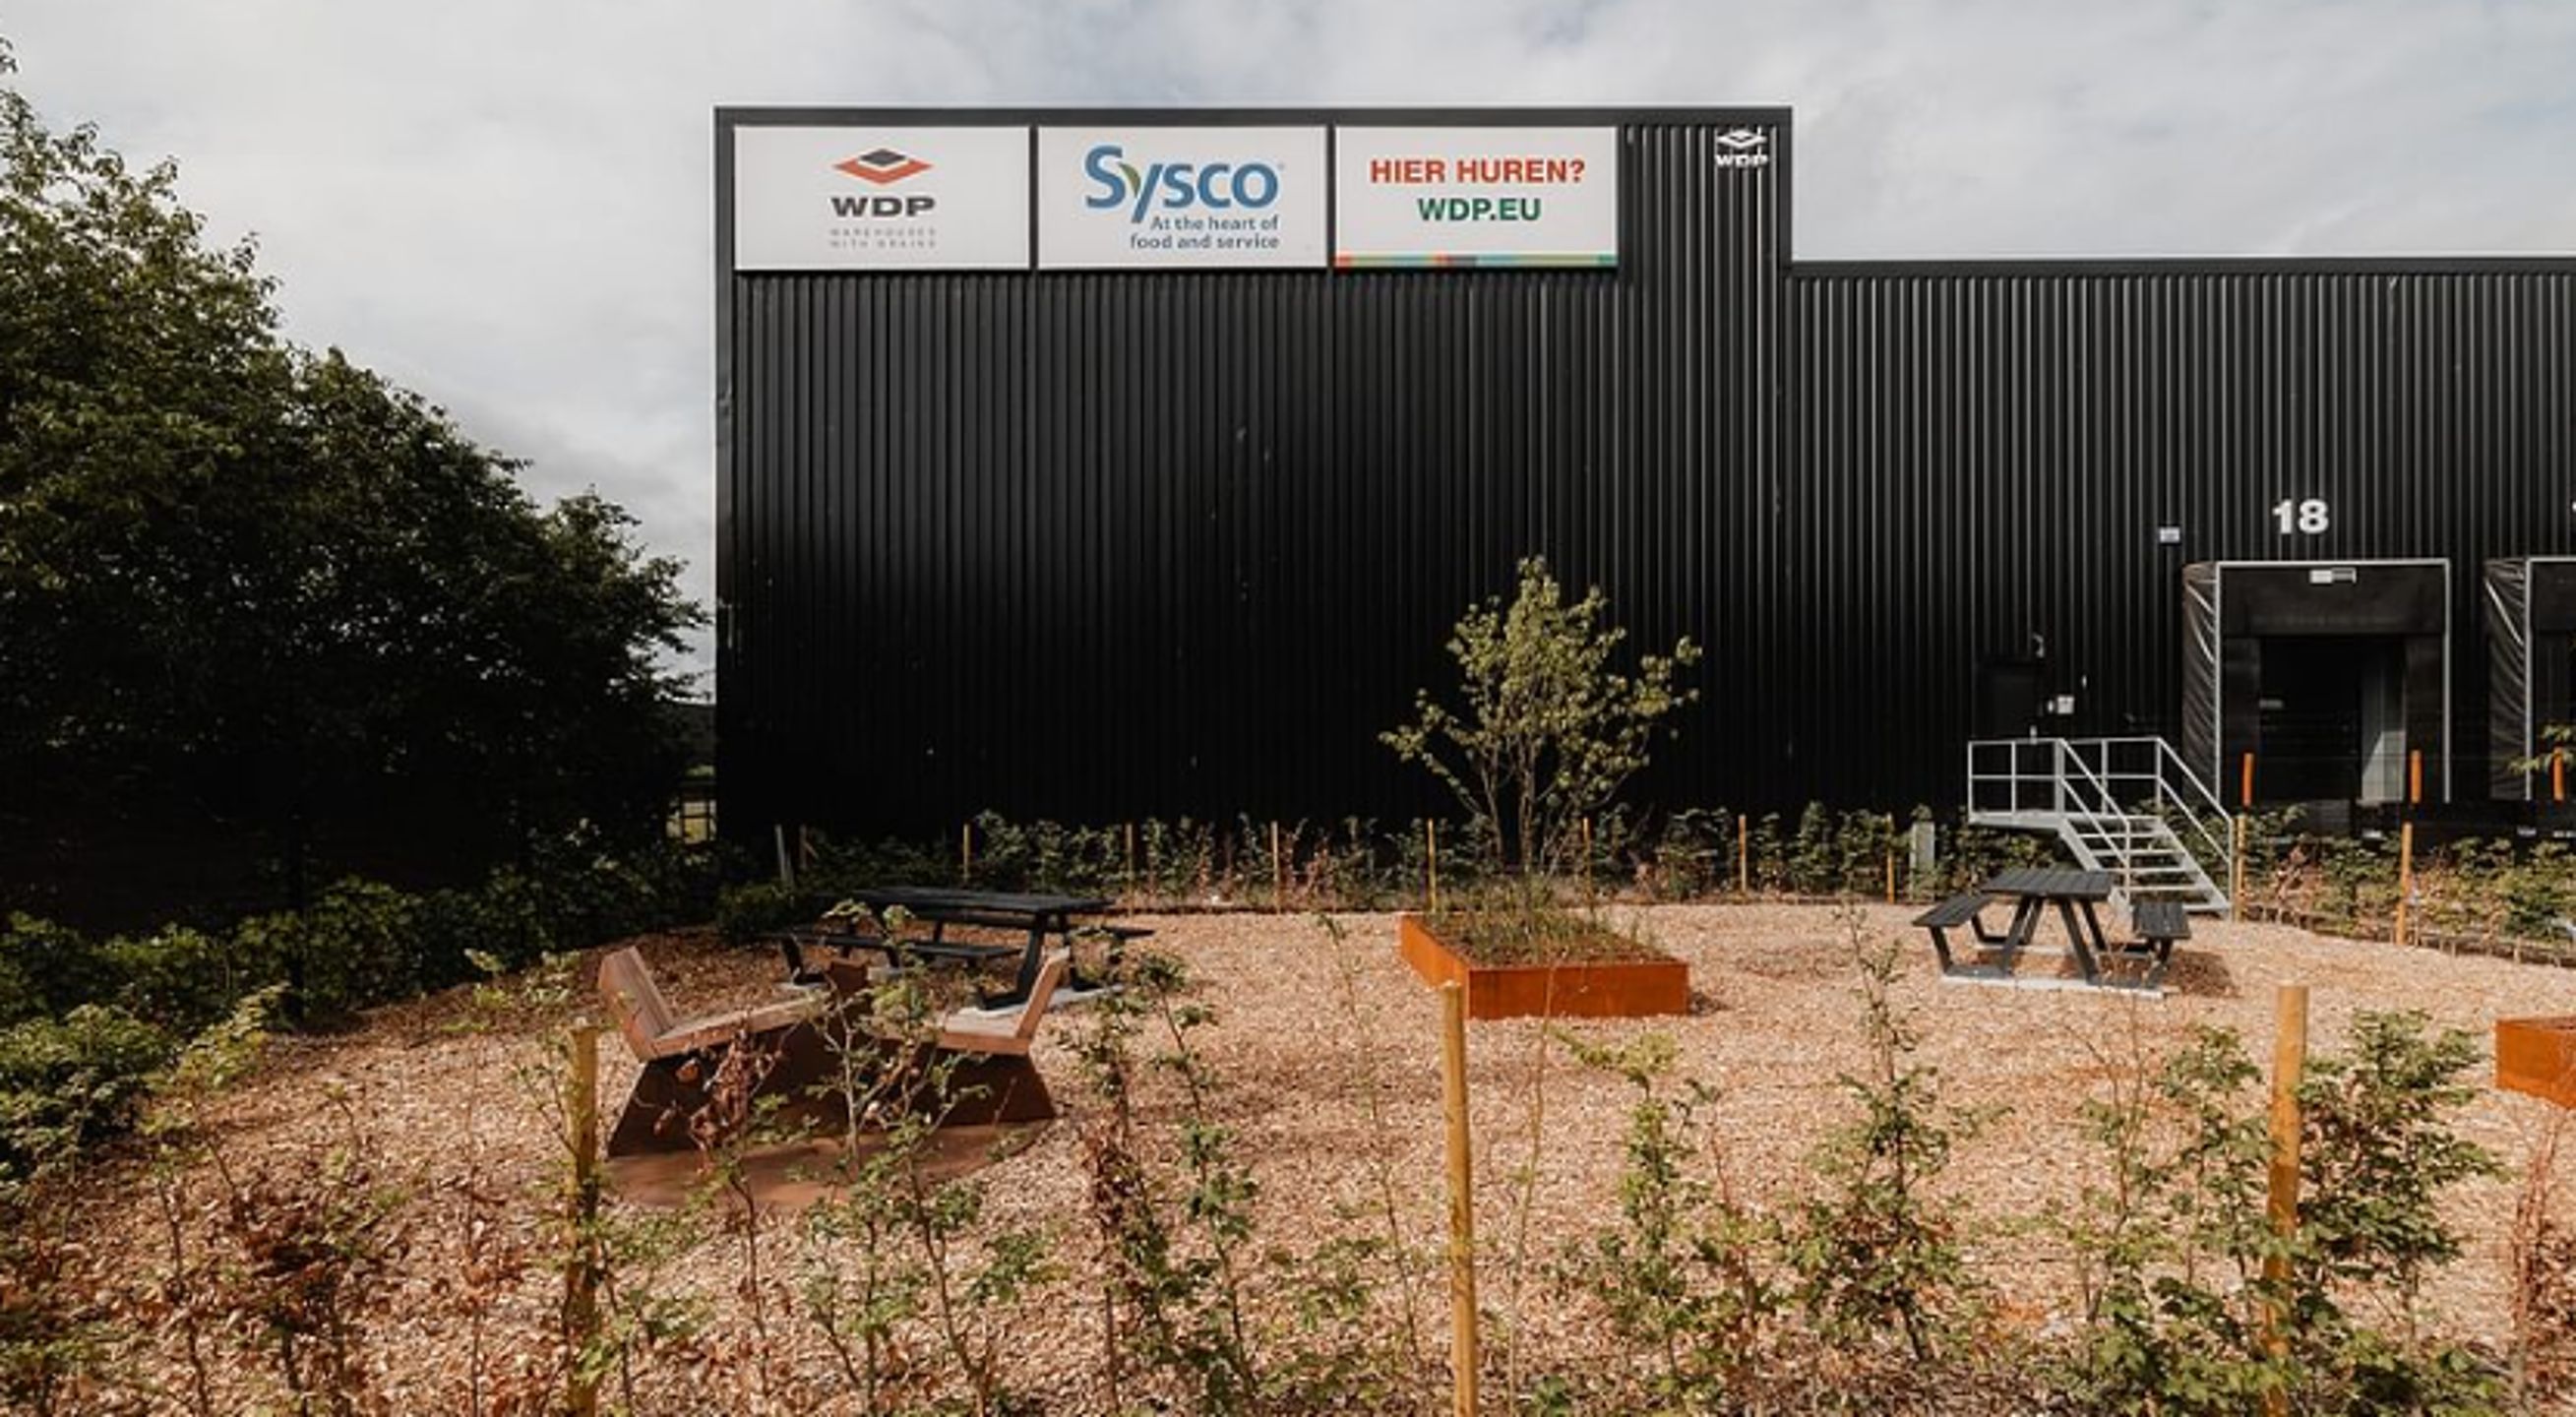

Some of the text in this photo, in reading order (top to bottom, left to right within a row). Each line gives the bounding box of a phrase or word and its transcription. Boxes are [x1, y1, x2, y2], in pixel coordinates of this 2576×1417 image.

[1370, 159, 1585, 183] HIER HUREN?
[1714, 154, 1768, 167] WDP
[1084, 145, 1279, 223] Sysco
[830, 196, 936, 216] WDP
[1417, 198, 1541, 220] WDP.EU
[1150, 215, 1279, 230] At the heart of
[1130, 233, 1279, 248] food and service
[2272, 499, 2329, 534] 18
